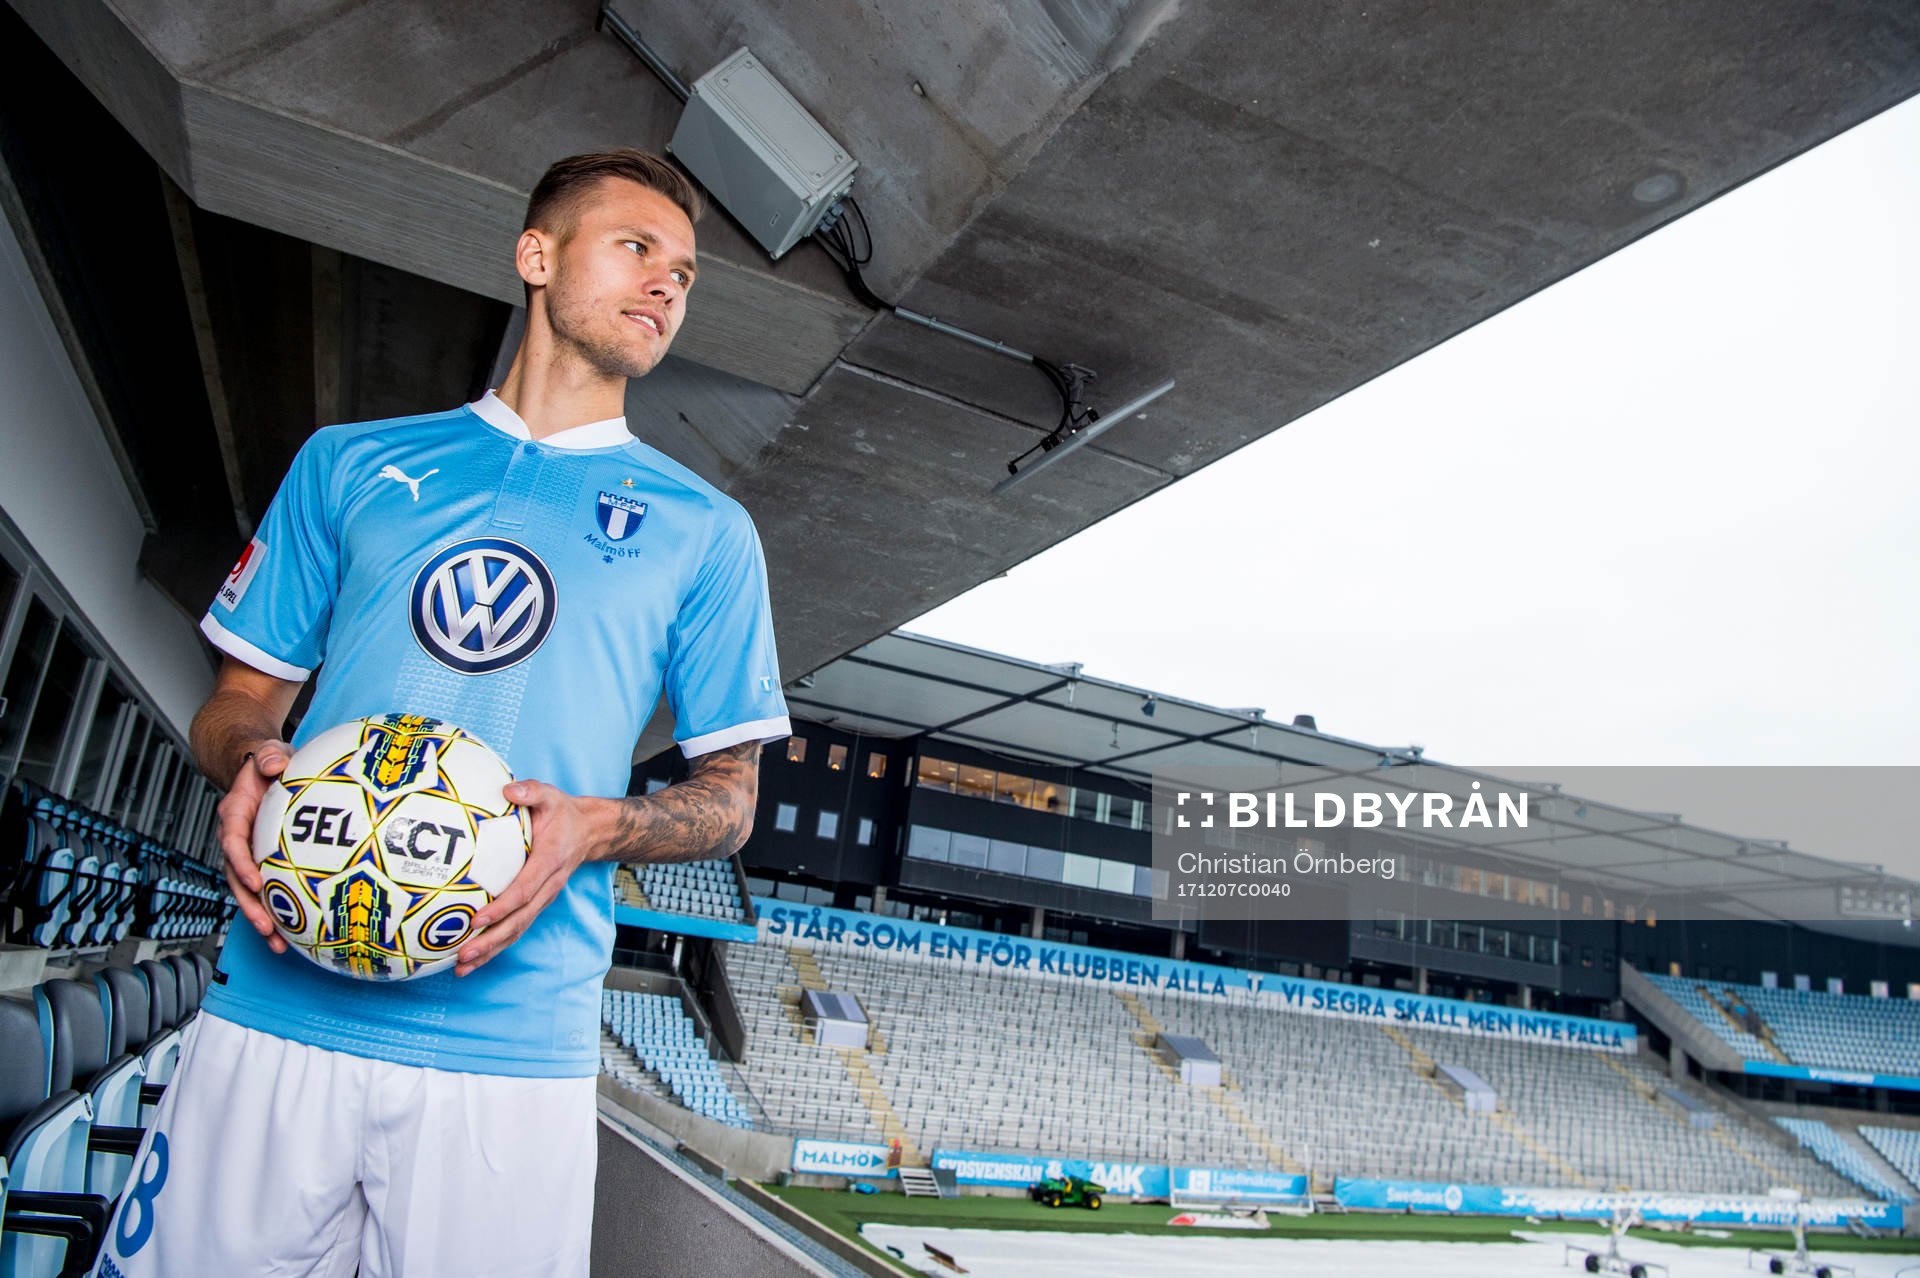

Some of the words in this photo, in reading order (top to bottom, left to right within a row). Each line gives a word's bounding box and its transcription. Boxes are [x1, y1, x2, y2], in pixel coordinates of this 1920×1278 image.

[584, 533, 625, 557] Malmö
[628, 547, 641, 558] FF
[222, 588, 237, 604] SPEL
[768, 907, 847, 944] STÅR
[853, 920, 921, 955] SOM
[929, 931, 968, 961] EN
[975, 936, 1032, 970] FÖR
[1039, 947, 1160, 987] KLUBBEN
[1165, 966, 1227, 997] ALLA
[1281, 981, 1306, 1008] VI
[1311, 987, 1386, 1018] SEGRA
[1393, 998, 1461, 1028] SKALL
[1468, 1009, 1512, 1036] MEN
[1518, 1014, 1562, 1041] INTE
[1566, 1021, 1623, 1048] FALLA
[802, 1150, 870, 1168] MALMÖ
